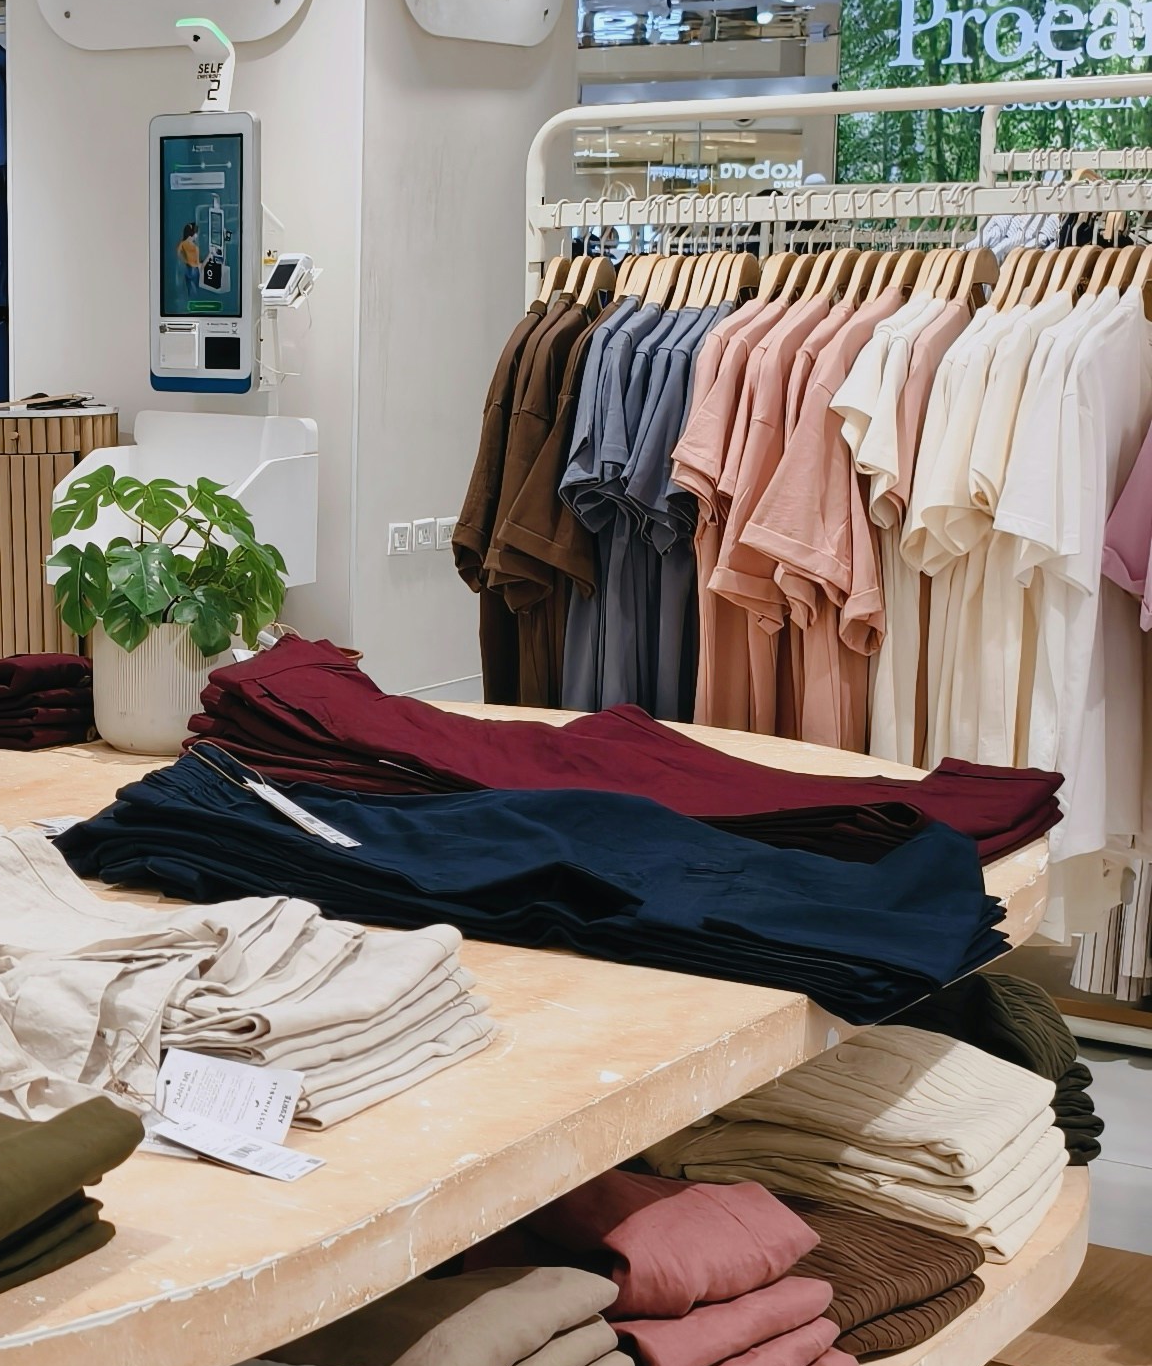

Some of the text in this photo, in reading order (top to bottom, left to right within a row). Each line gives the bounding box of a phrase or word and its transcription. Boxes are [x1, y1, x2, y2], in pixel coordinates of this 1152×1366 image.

[198, 63, 223, 74] SELF
[207, 79, 221, 101] 2
[255, 1081, 278, 1131] SUSTAINABLE
